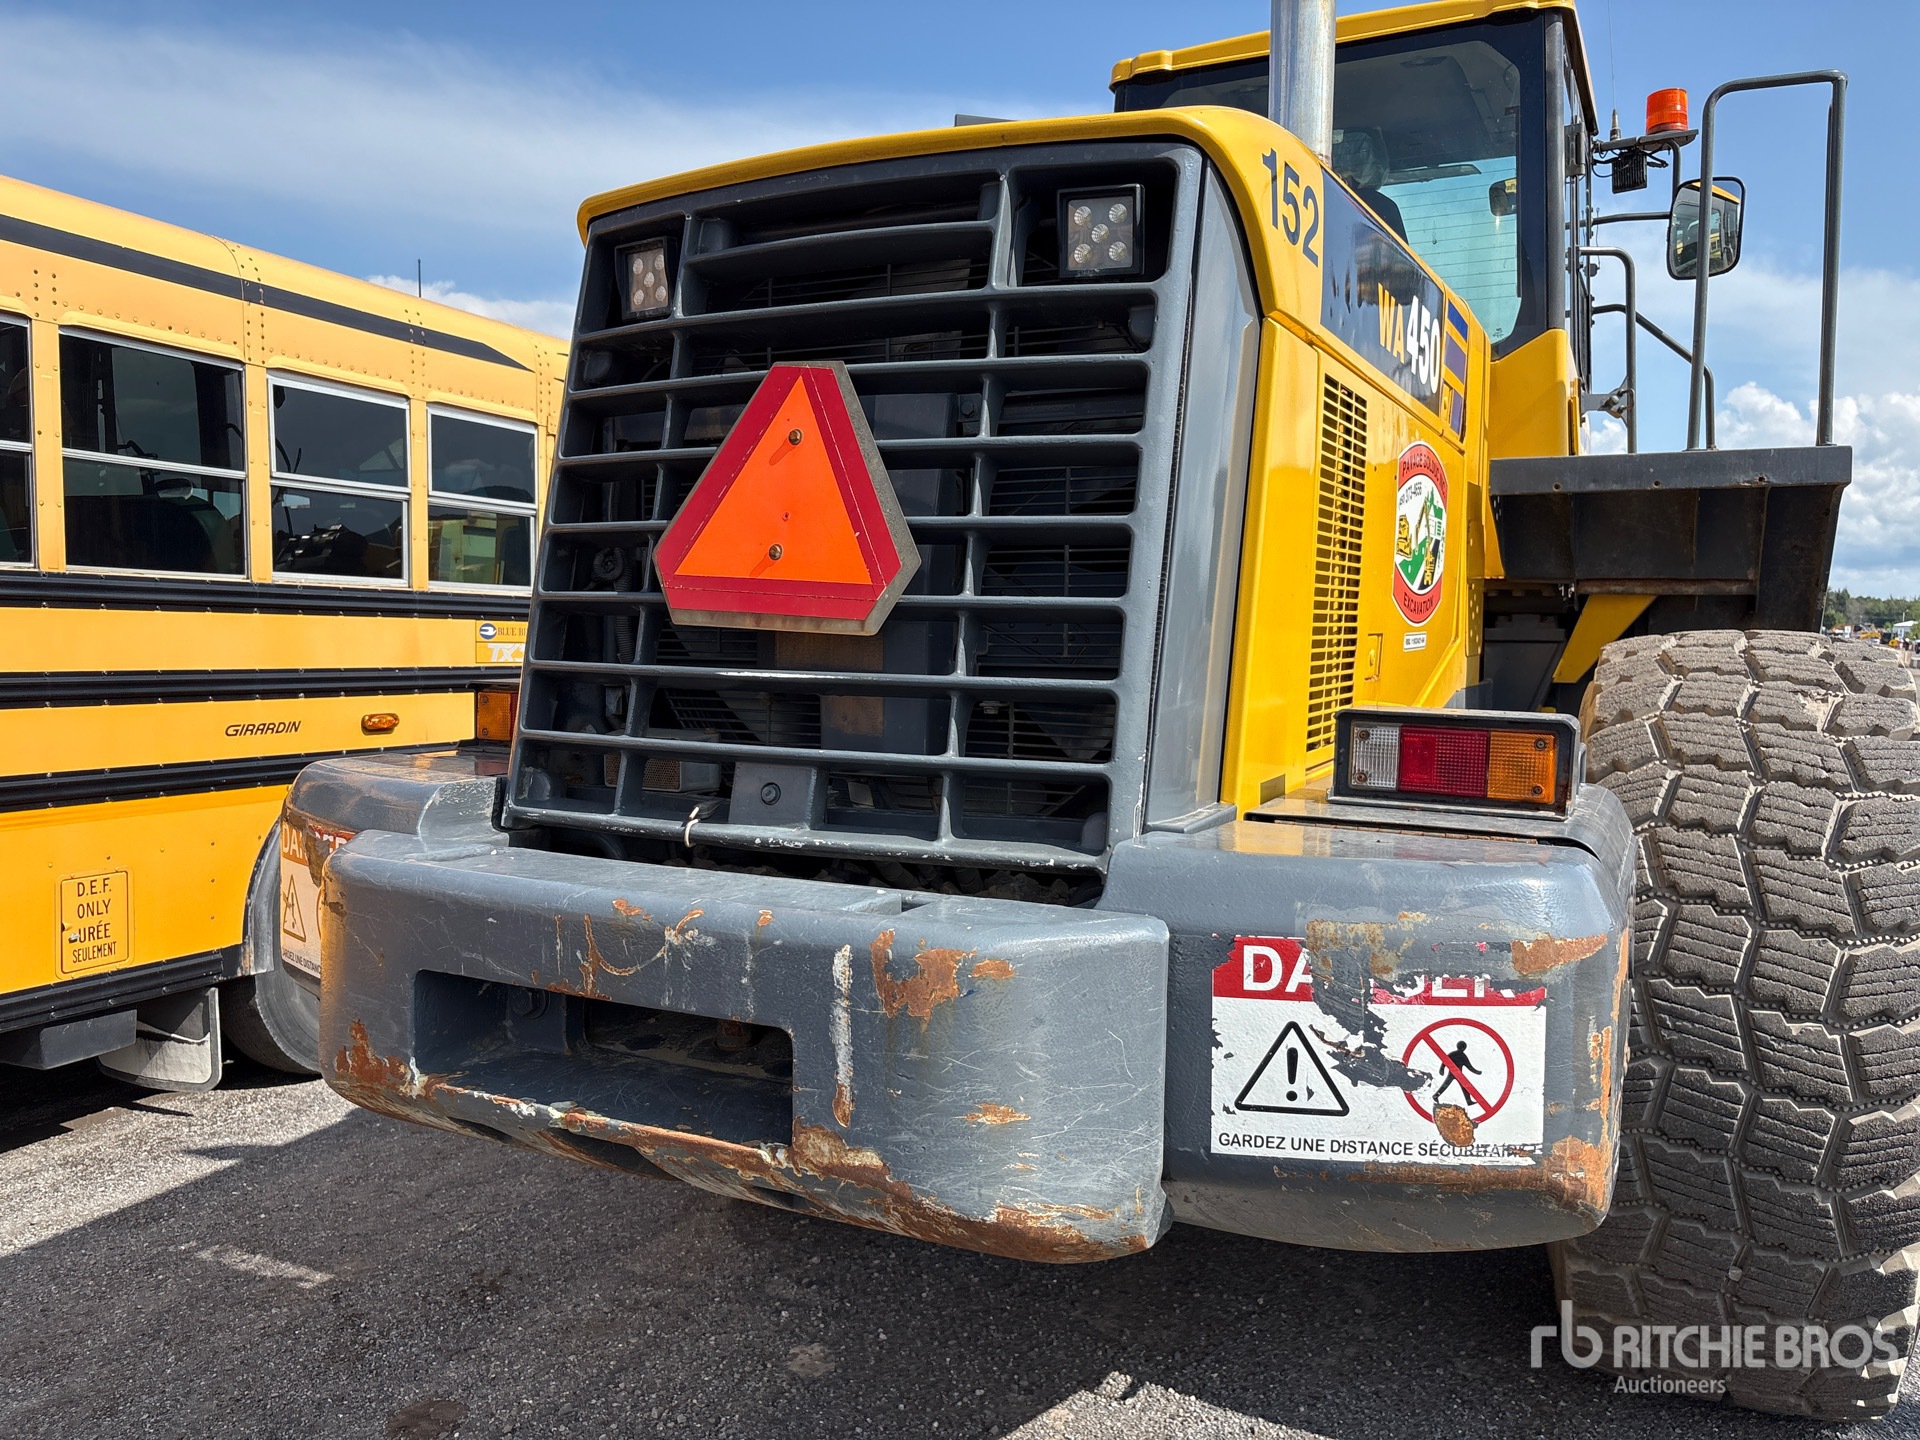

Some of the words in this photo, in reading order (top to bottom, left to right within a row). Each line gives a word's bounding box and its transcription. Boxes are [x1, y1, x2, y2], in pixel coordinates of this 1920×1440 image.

[1261, 147, 1319, 268] 152
[1403, 591, 1434, 615] EXCAVATION
[497, 627, 517, 637] BLUE
[225, 720, 302, 737] GIRARDIN
[77, 877, 112, 897] D.E.F.
[77, 898, 111, 919] ONLY
[78, 920, 111, 944] URÉE
[72, 941, 117, 964] SEULEMENT
[1218, 1132, 1286, 1150] GARDEZ
[1290, 1137, 1326, 1152] UNE
[1330, 1139, 1413, 1157] DISTANCE
